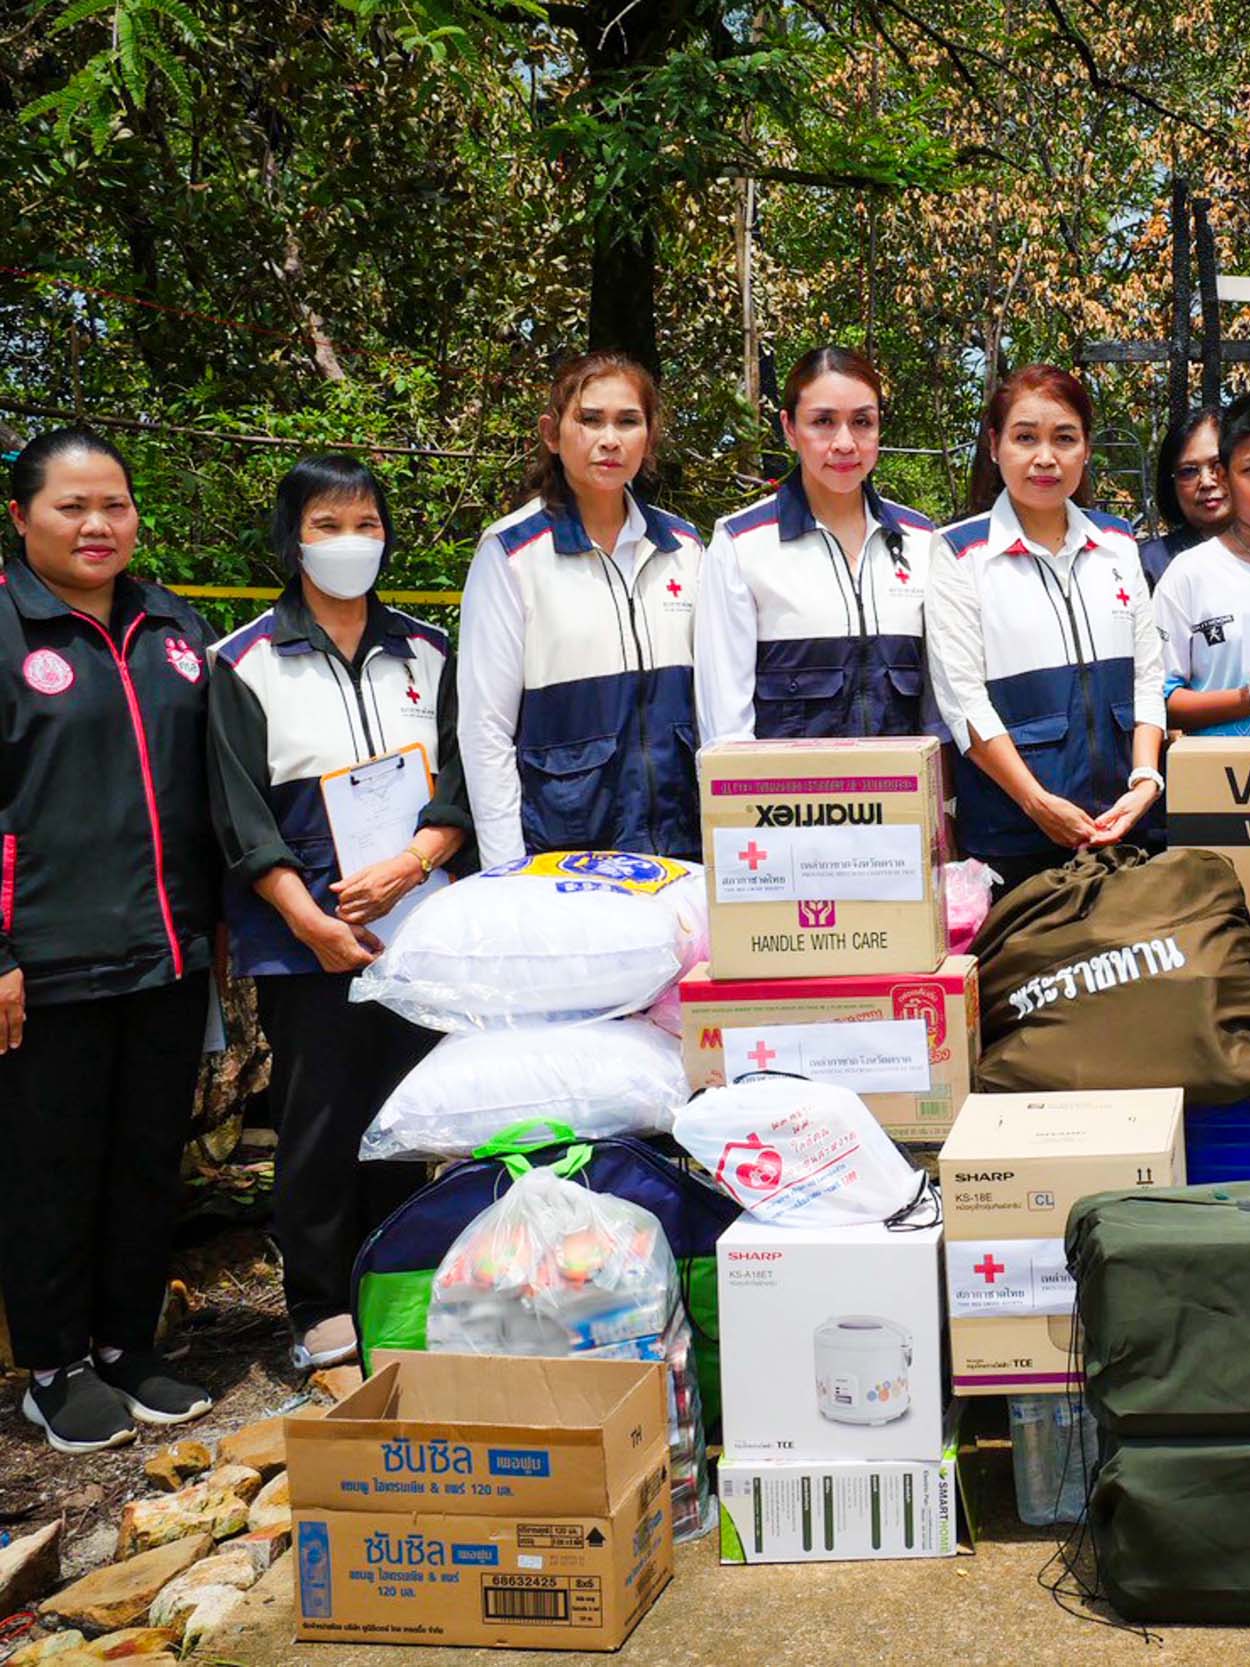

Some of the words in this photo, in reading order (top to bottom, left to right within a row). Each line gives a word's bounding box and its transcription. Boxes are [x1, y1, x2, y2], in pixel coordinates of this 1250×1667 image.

[751, 933, 805, 952] HANDLE
[810, 932, 847, 950] WITH
[853, 931, 888, 949] CARE
[1008, 937, 1186, 1020] พระราชทาน
[954, 1171, 1015, 1183] SHARP
[728, 1251, 783, 1261] SHARP
[382, 1437, 474, 1475] ซันซิล
[430, 1483, 440, 1493] &
[472, 1483, 492, 1495] 120
[364, 1530, 445, 1566] ซันซิล
[378, 1586, 396, 1597] 120
